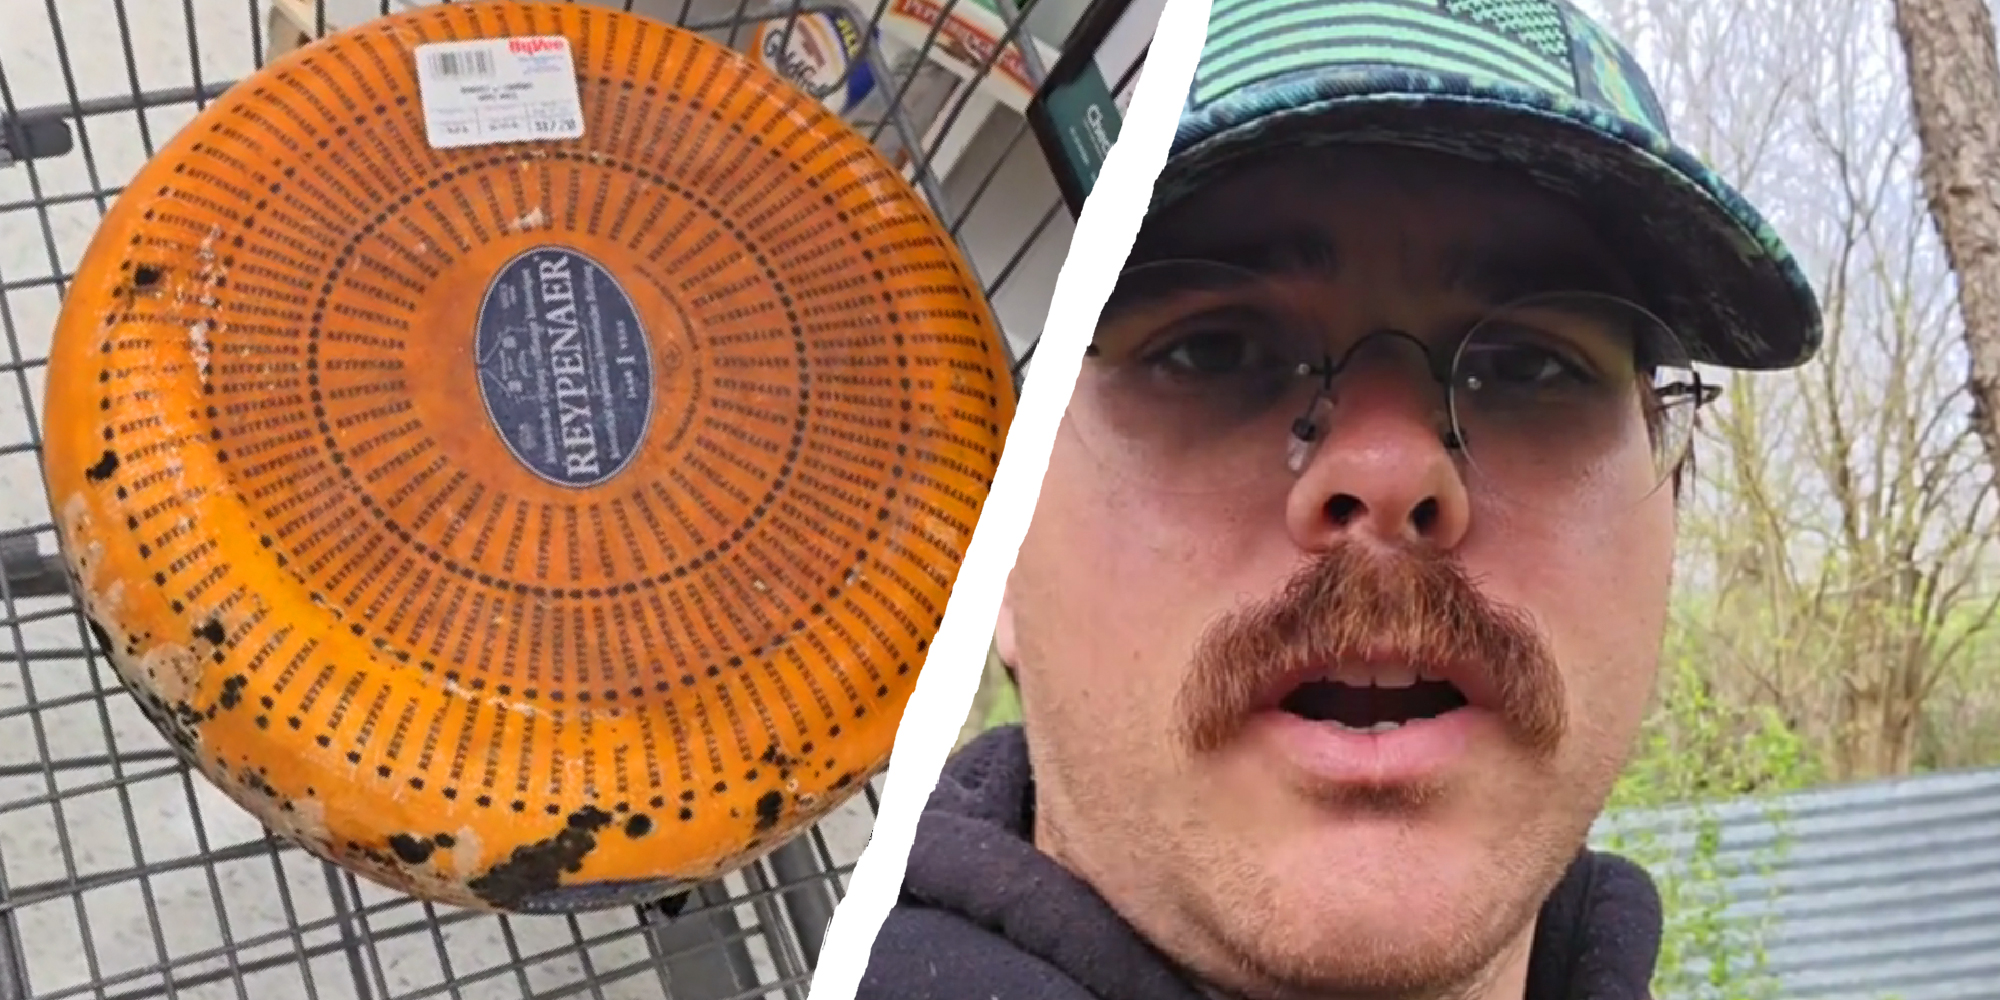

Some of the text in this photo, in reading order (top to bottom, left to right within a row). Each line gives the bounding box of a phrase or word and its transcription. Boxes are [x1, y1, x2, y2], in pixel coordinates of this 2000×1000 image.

[539, 255, 600, 477] REYPENAER
[273, 637, 320, 694] REYPENA
[327, 671, 368, 731] REYPENA
[356, 684, 392, 747] REYPENA
[386, 697, 419, 761] REYPENA
